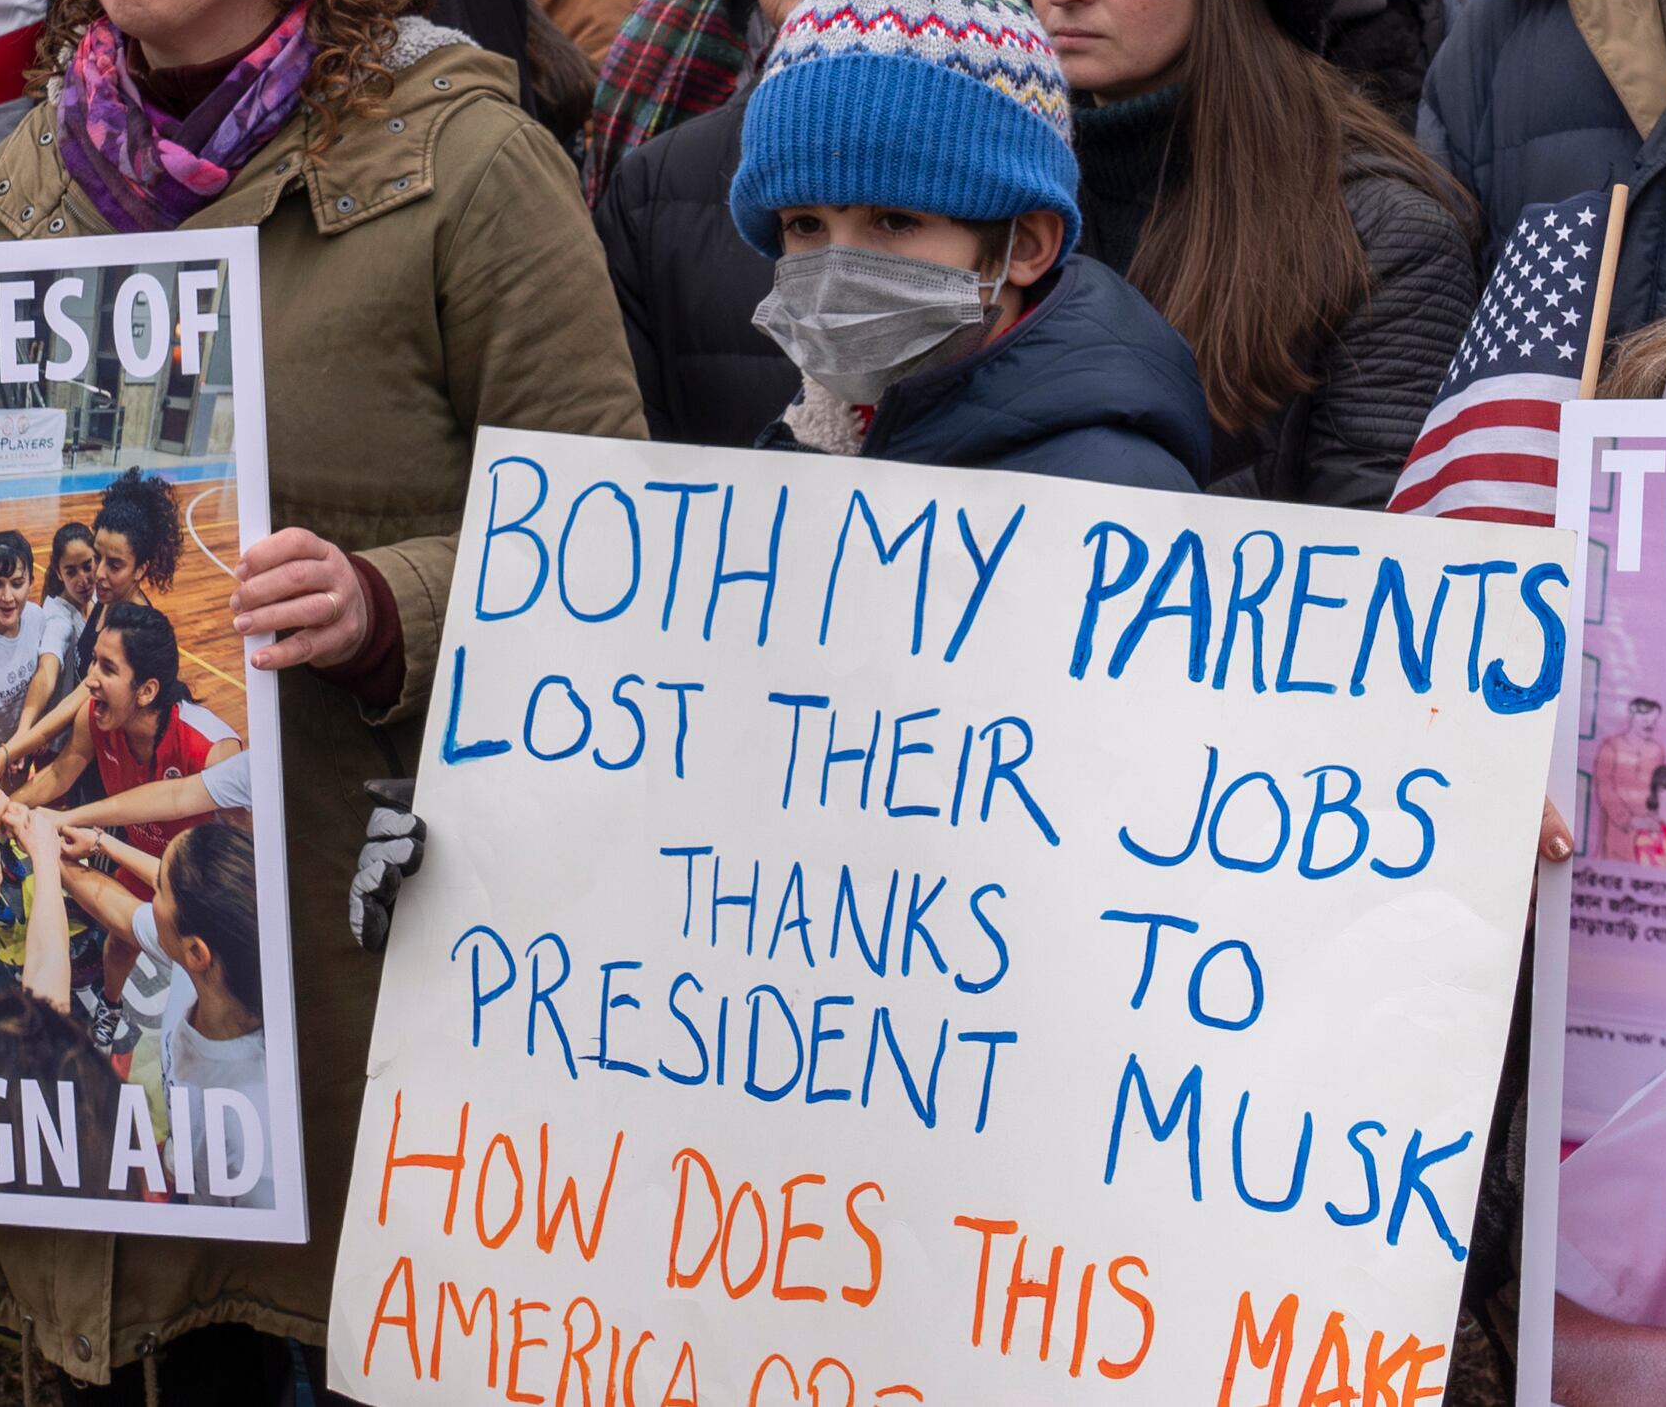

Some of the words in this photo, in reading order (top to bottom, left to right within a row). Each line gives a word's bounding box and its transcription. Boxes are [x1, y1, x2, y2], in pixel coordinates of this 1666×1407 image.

[113, 270, 219, 379] OF
[475, 456, 787, 647] BOTH
[819, 488, 1025, 661] MY
[1070, 521, 1569, 714] PARENTS
[440, 646, 704, 779] LOST
[767, 692, 1060, 846] THEIR
[1119, 746, 1451, 880] JOBS
[660, 845, 1009, 993] THANKS
[1100, 908, 1264, 1030] TO
[107, 1083, 263, 1197] AID
[451, 925, 1018, 1134] PRESIDENT
[1103, 1054, 1472, 1261] MUSK
[364, 1256, 700, 1407] AMERICA
[377, 1091, 624, 1263] HOW
[665, 1147, 884, 1306] DOES
[955, 1216, 1155, 1379] THIS
[1217, 1290, 1447, 1407] MAKE
